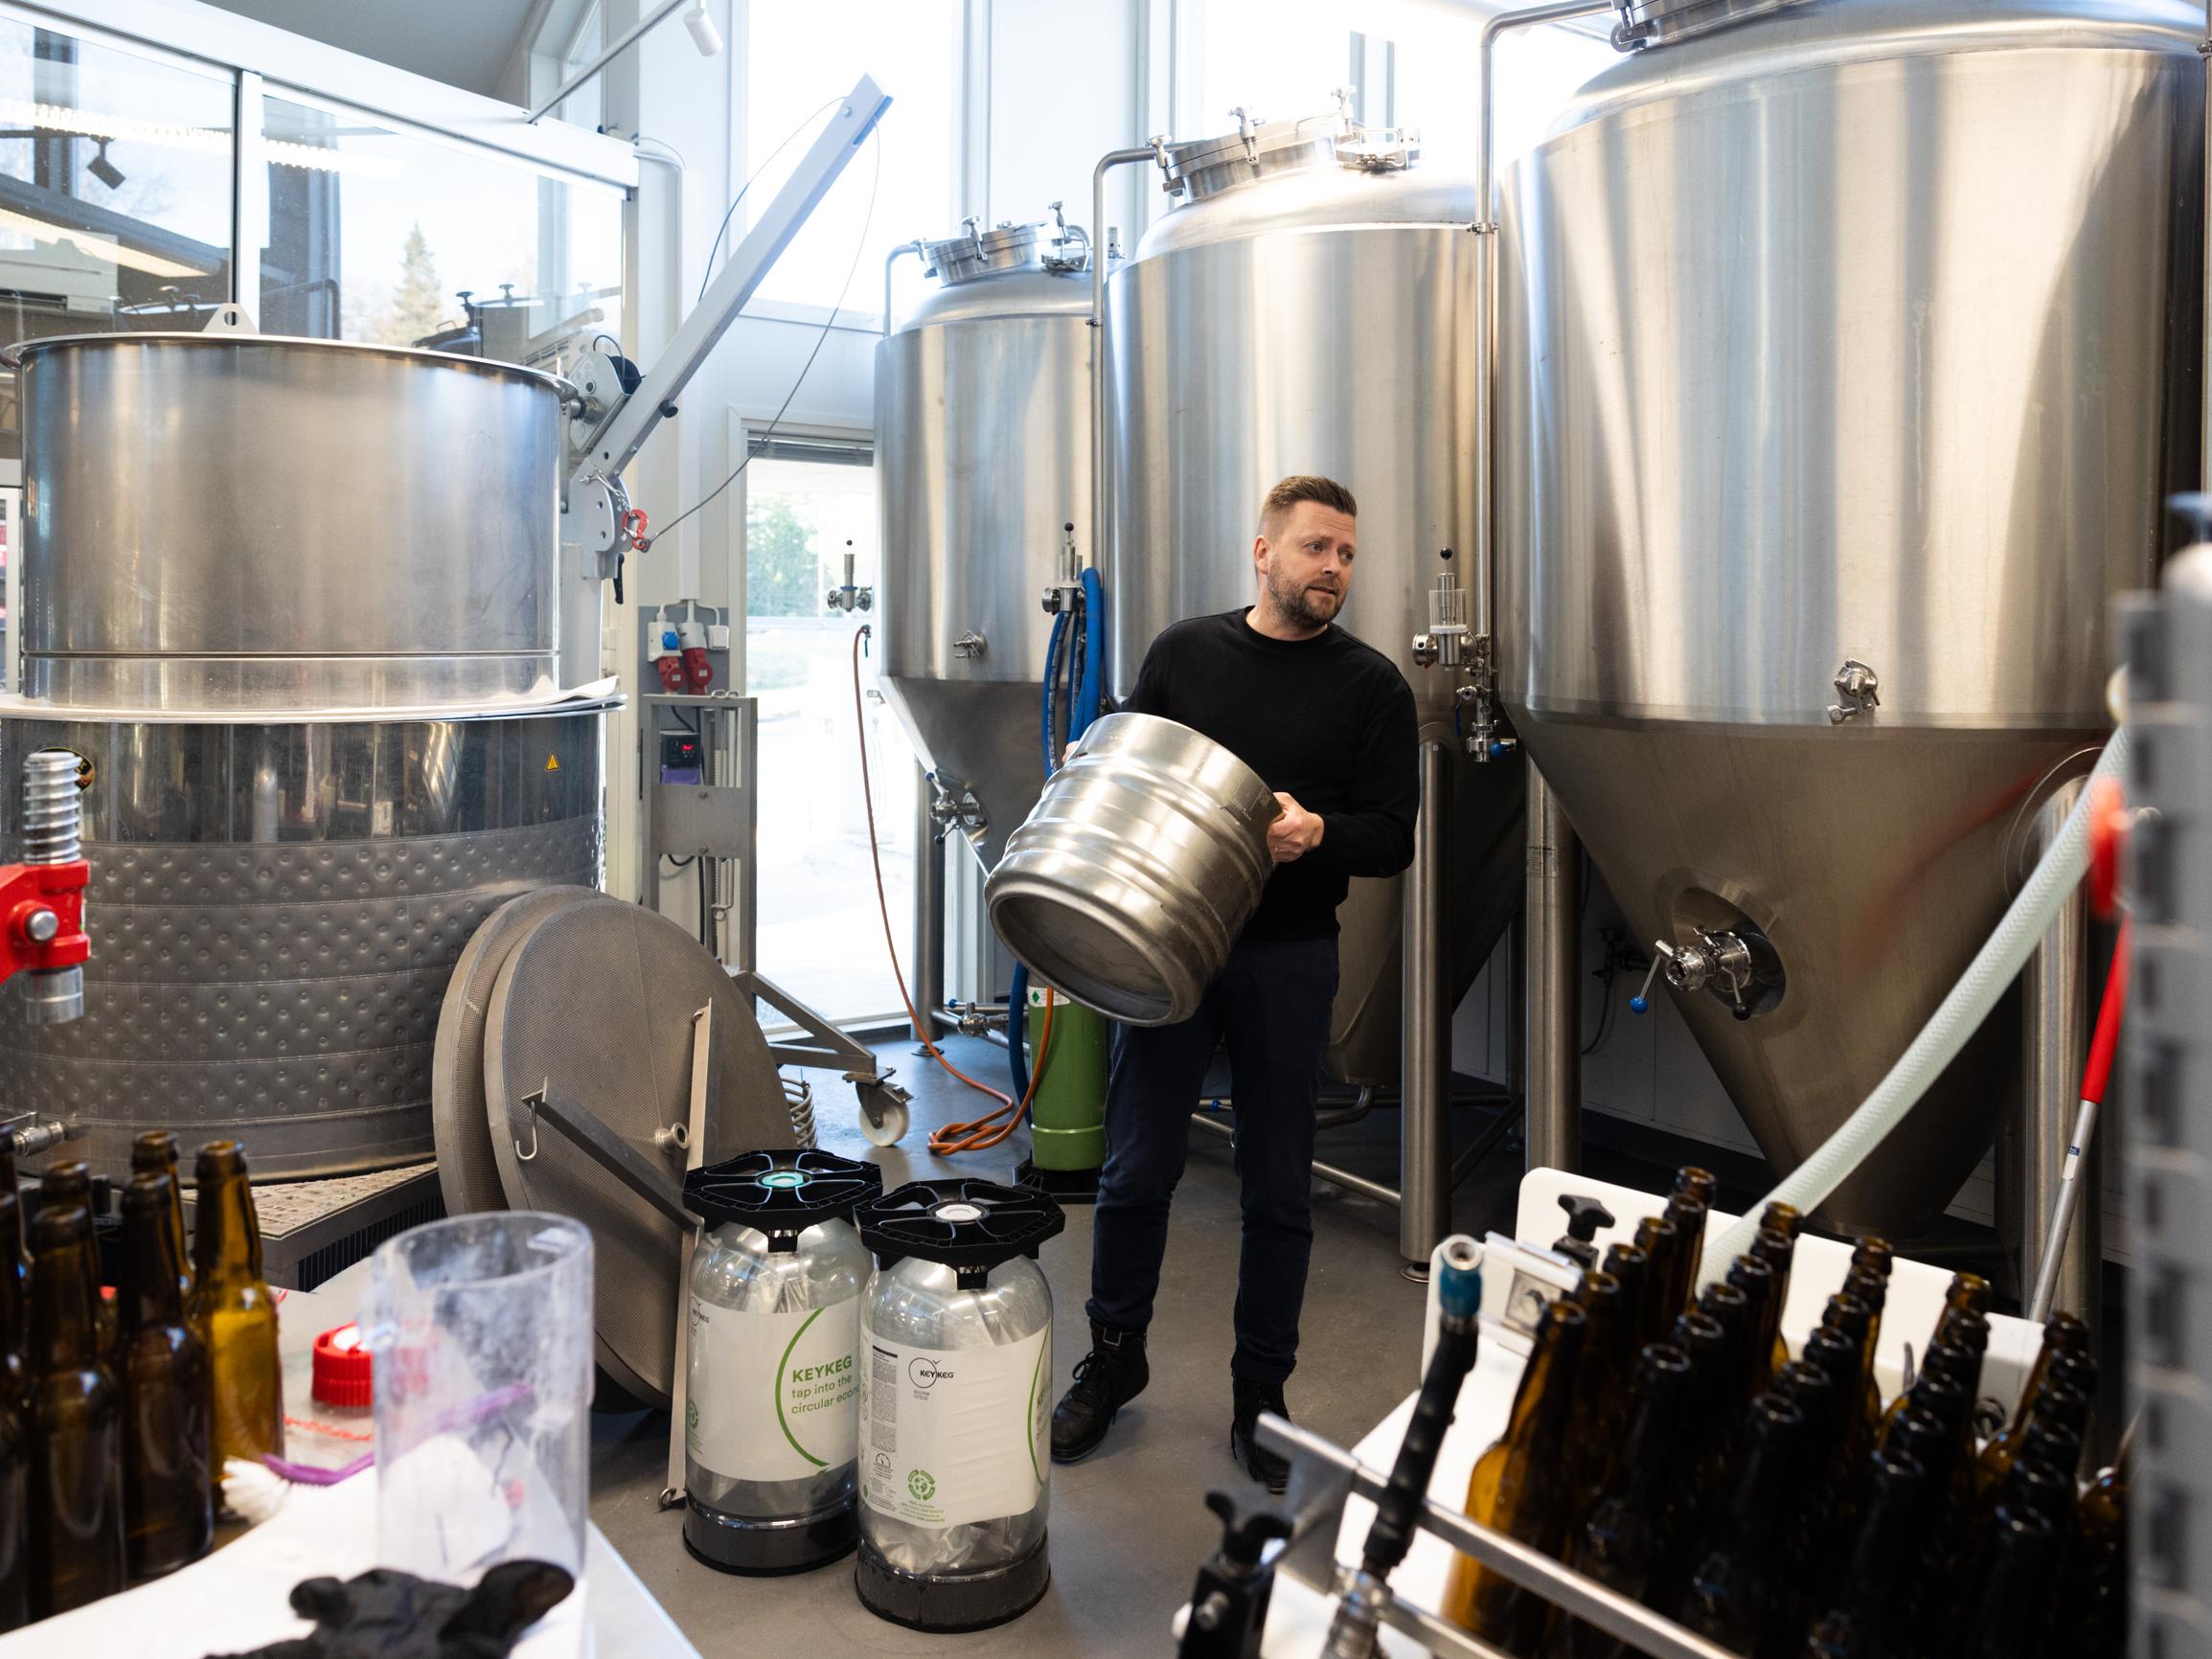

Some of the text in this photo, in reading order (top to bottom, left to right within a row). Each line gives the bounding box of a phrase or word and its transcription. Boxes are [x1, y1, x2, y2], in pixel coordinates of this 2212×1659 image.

[792, 1355, 853, 1383] KEYKEG
[920, 1370, 954, 1378] KEYKEG
[792, 1375, 853, 1399] tap into the
[791, 1398, 835, 1415] circular
